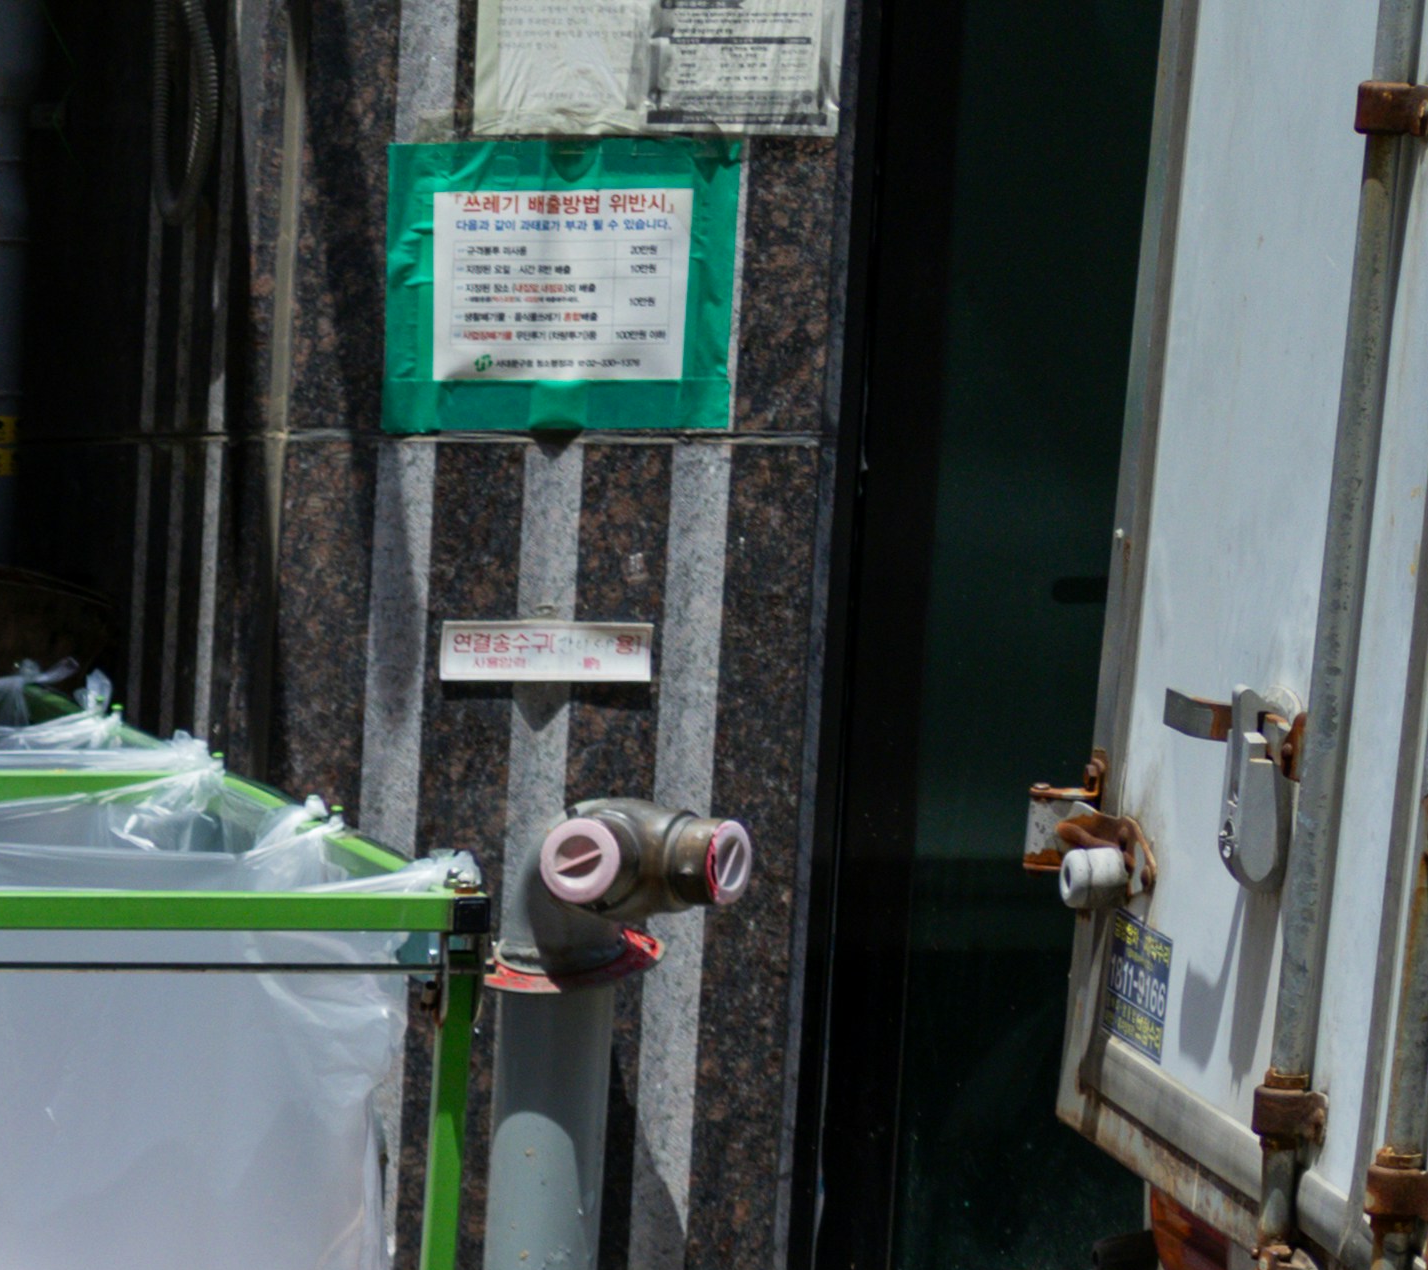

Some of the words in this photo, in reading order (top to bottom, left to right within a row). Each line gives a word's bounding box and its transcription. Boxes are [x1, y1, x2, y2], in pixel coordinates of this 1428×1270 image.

[527, 194, 600, 213] 배출방법
[455, 219, 490, 231] 다음과
[564, 219, 588, 231] 부과
[607, 219, 619, 230] 수
[622, 218, 671, 230] 있습니다.
[1110, 957, 1166, 1017] 1811-9166
